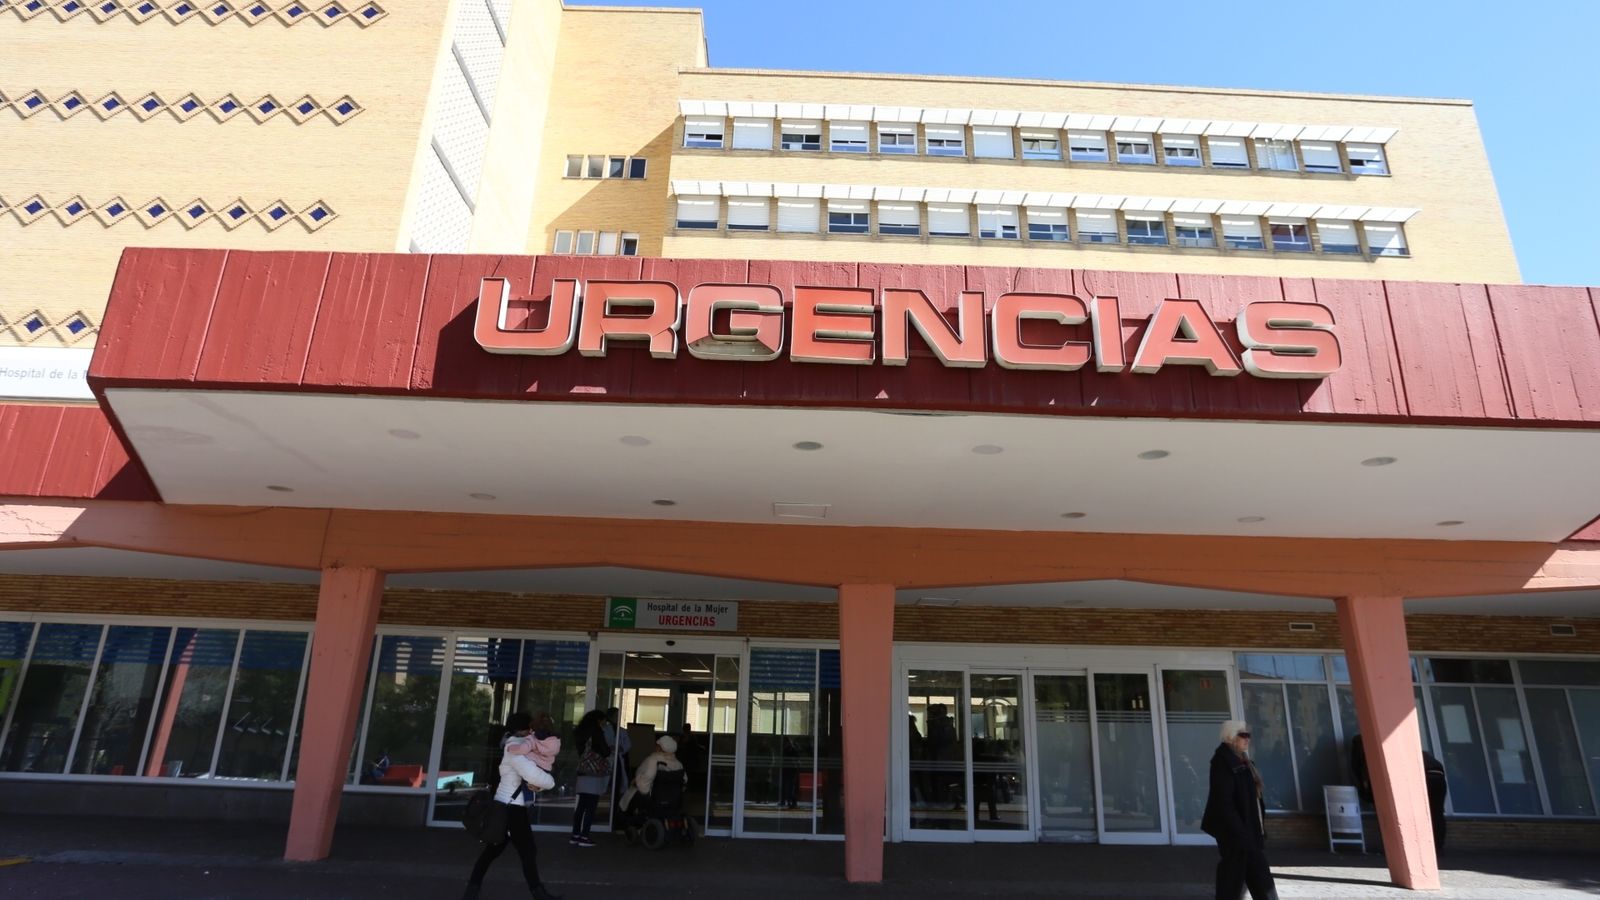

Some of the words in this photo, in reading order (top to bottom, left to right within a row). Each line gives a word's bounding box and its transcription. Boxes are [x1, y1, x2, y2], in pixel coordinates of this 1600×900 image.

[473, 276, 1342, 380] URGENCIAS
[0, 367, 46, 380] Hospital
[49, 368, 64, 379] de
[67, 369, 78, 380] la
[647, 602, 678, 613] Hospital
[681, 603, 691, 612] de
[694, 604, 702, 613] la
[705, 604, 729, 616] Mujer
[658, 615, 716, 627] URGENCIAS
